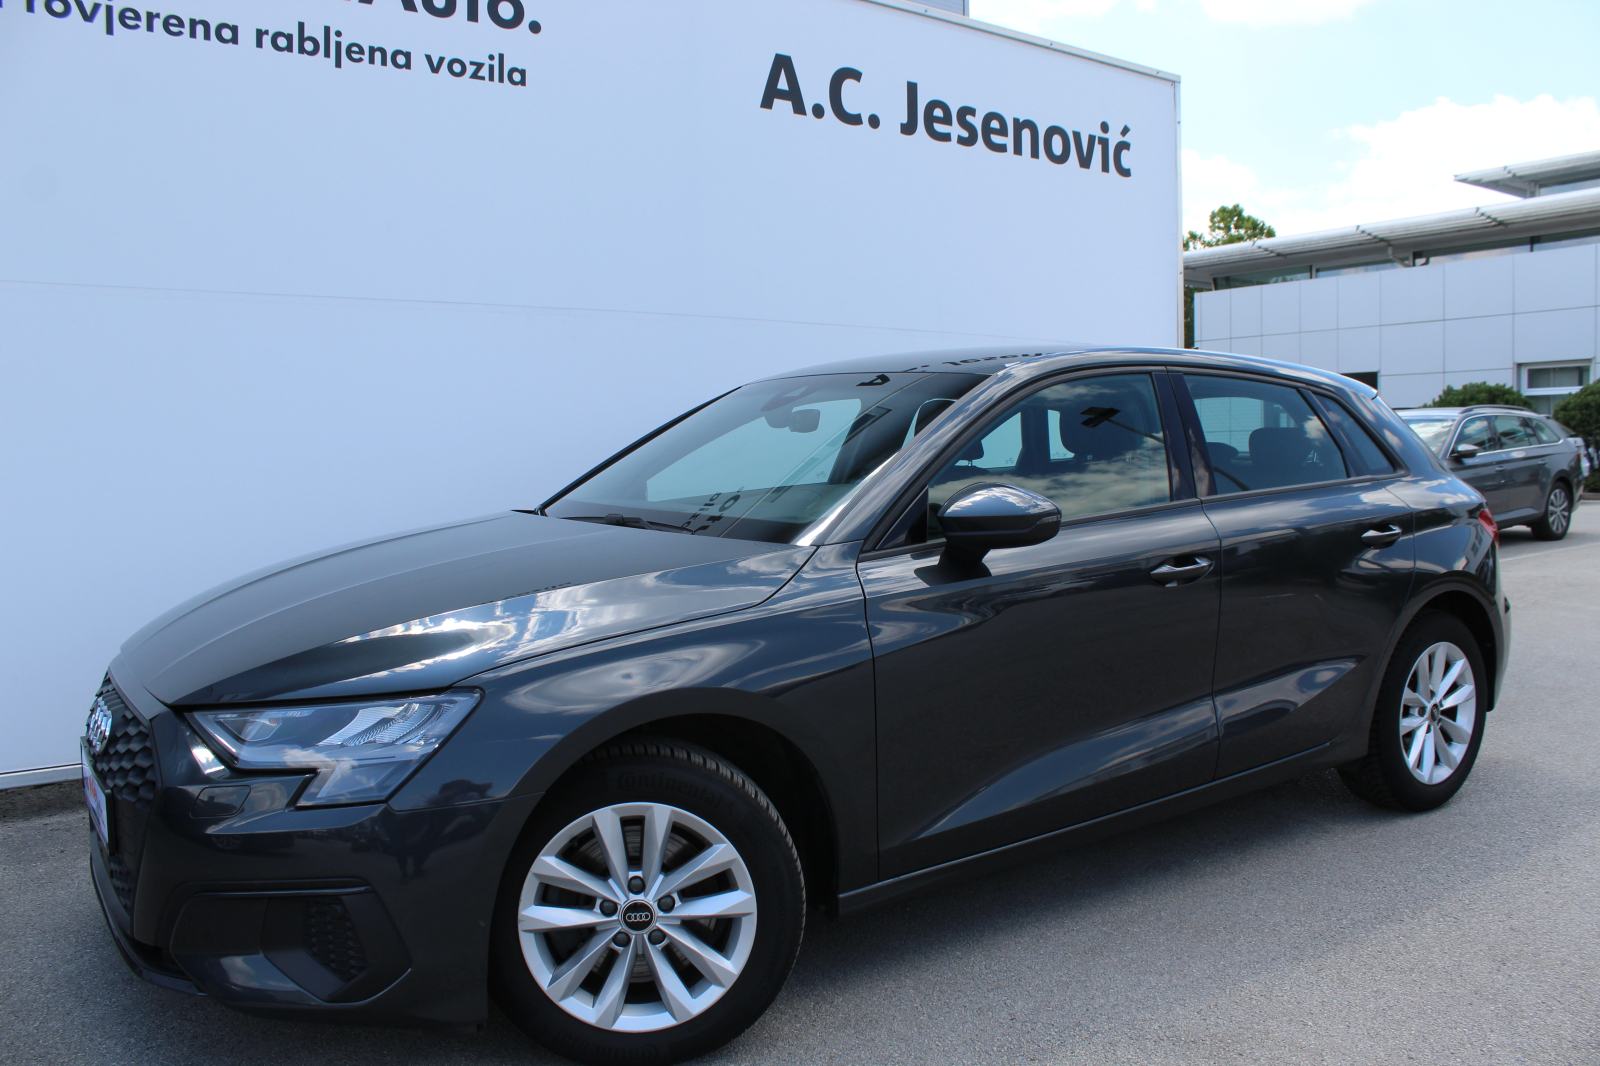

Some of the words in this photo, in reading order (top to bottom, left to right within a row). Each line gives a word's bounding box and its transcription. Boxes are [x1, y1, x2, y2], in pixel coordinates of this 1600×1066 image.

[0, 0, 239, 47] ovjerena
[256, 21, 412, 79] rabljena
[425, 53, 527, 87] vozila
[760, 53, 881, 130] A.C.
[900, 81, 1132, 178] Jesenović
